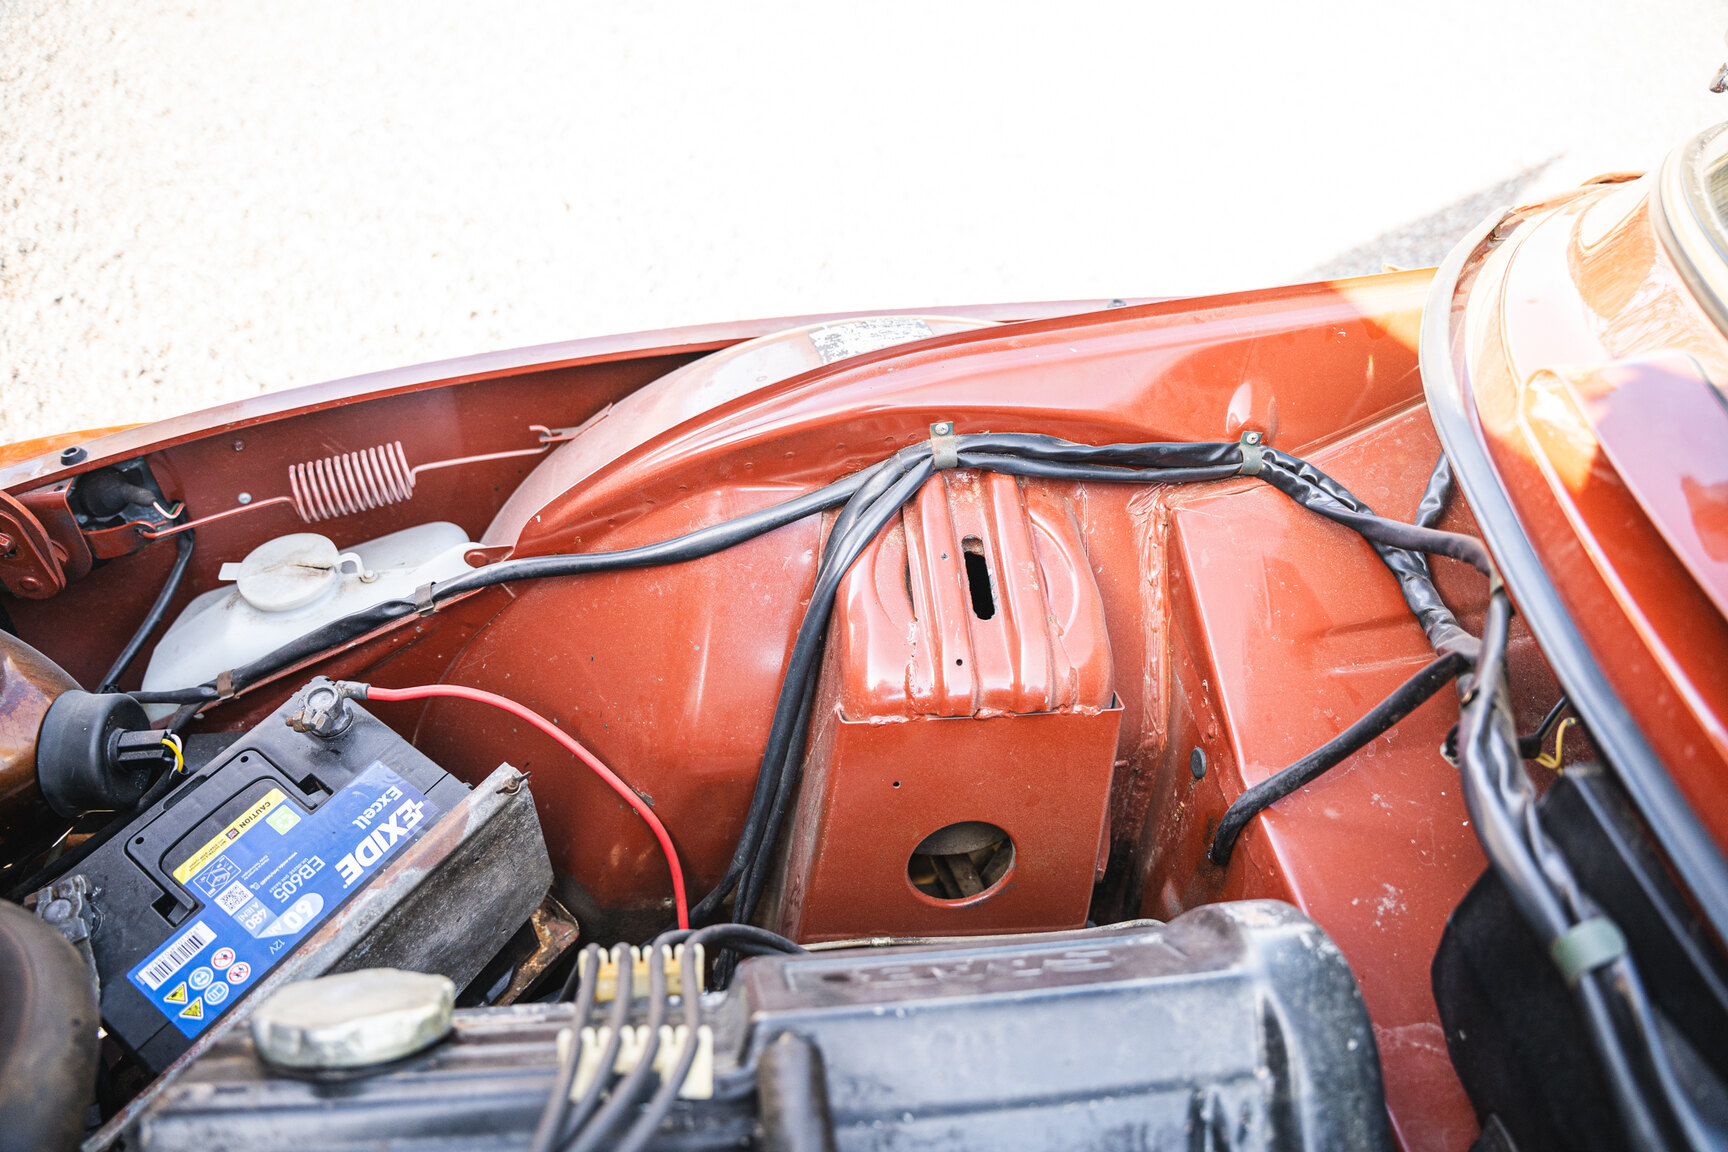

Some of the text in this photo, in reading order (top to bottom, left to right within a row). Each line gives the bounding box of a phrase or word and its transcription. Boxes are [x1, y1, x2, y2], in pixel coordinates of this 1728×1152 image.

[239, 801, 271, 829] CAUTION
[352, 785, 404, 830] Excell
[334, 798, 425, 887] EXIDE
[273, 855, 326, 903] EB605
[245, 907, 268, 930] 480
[283, 900, 314, 930] 60
[269, 938, 286, 955] 12V
